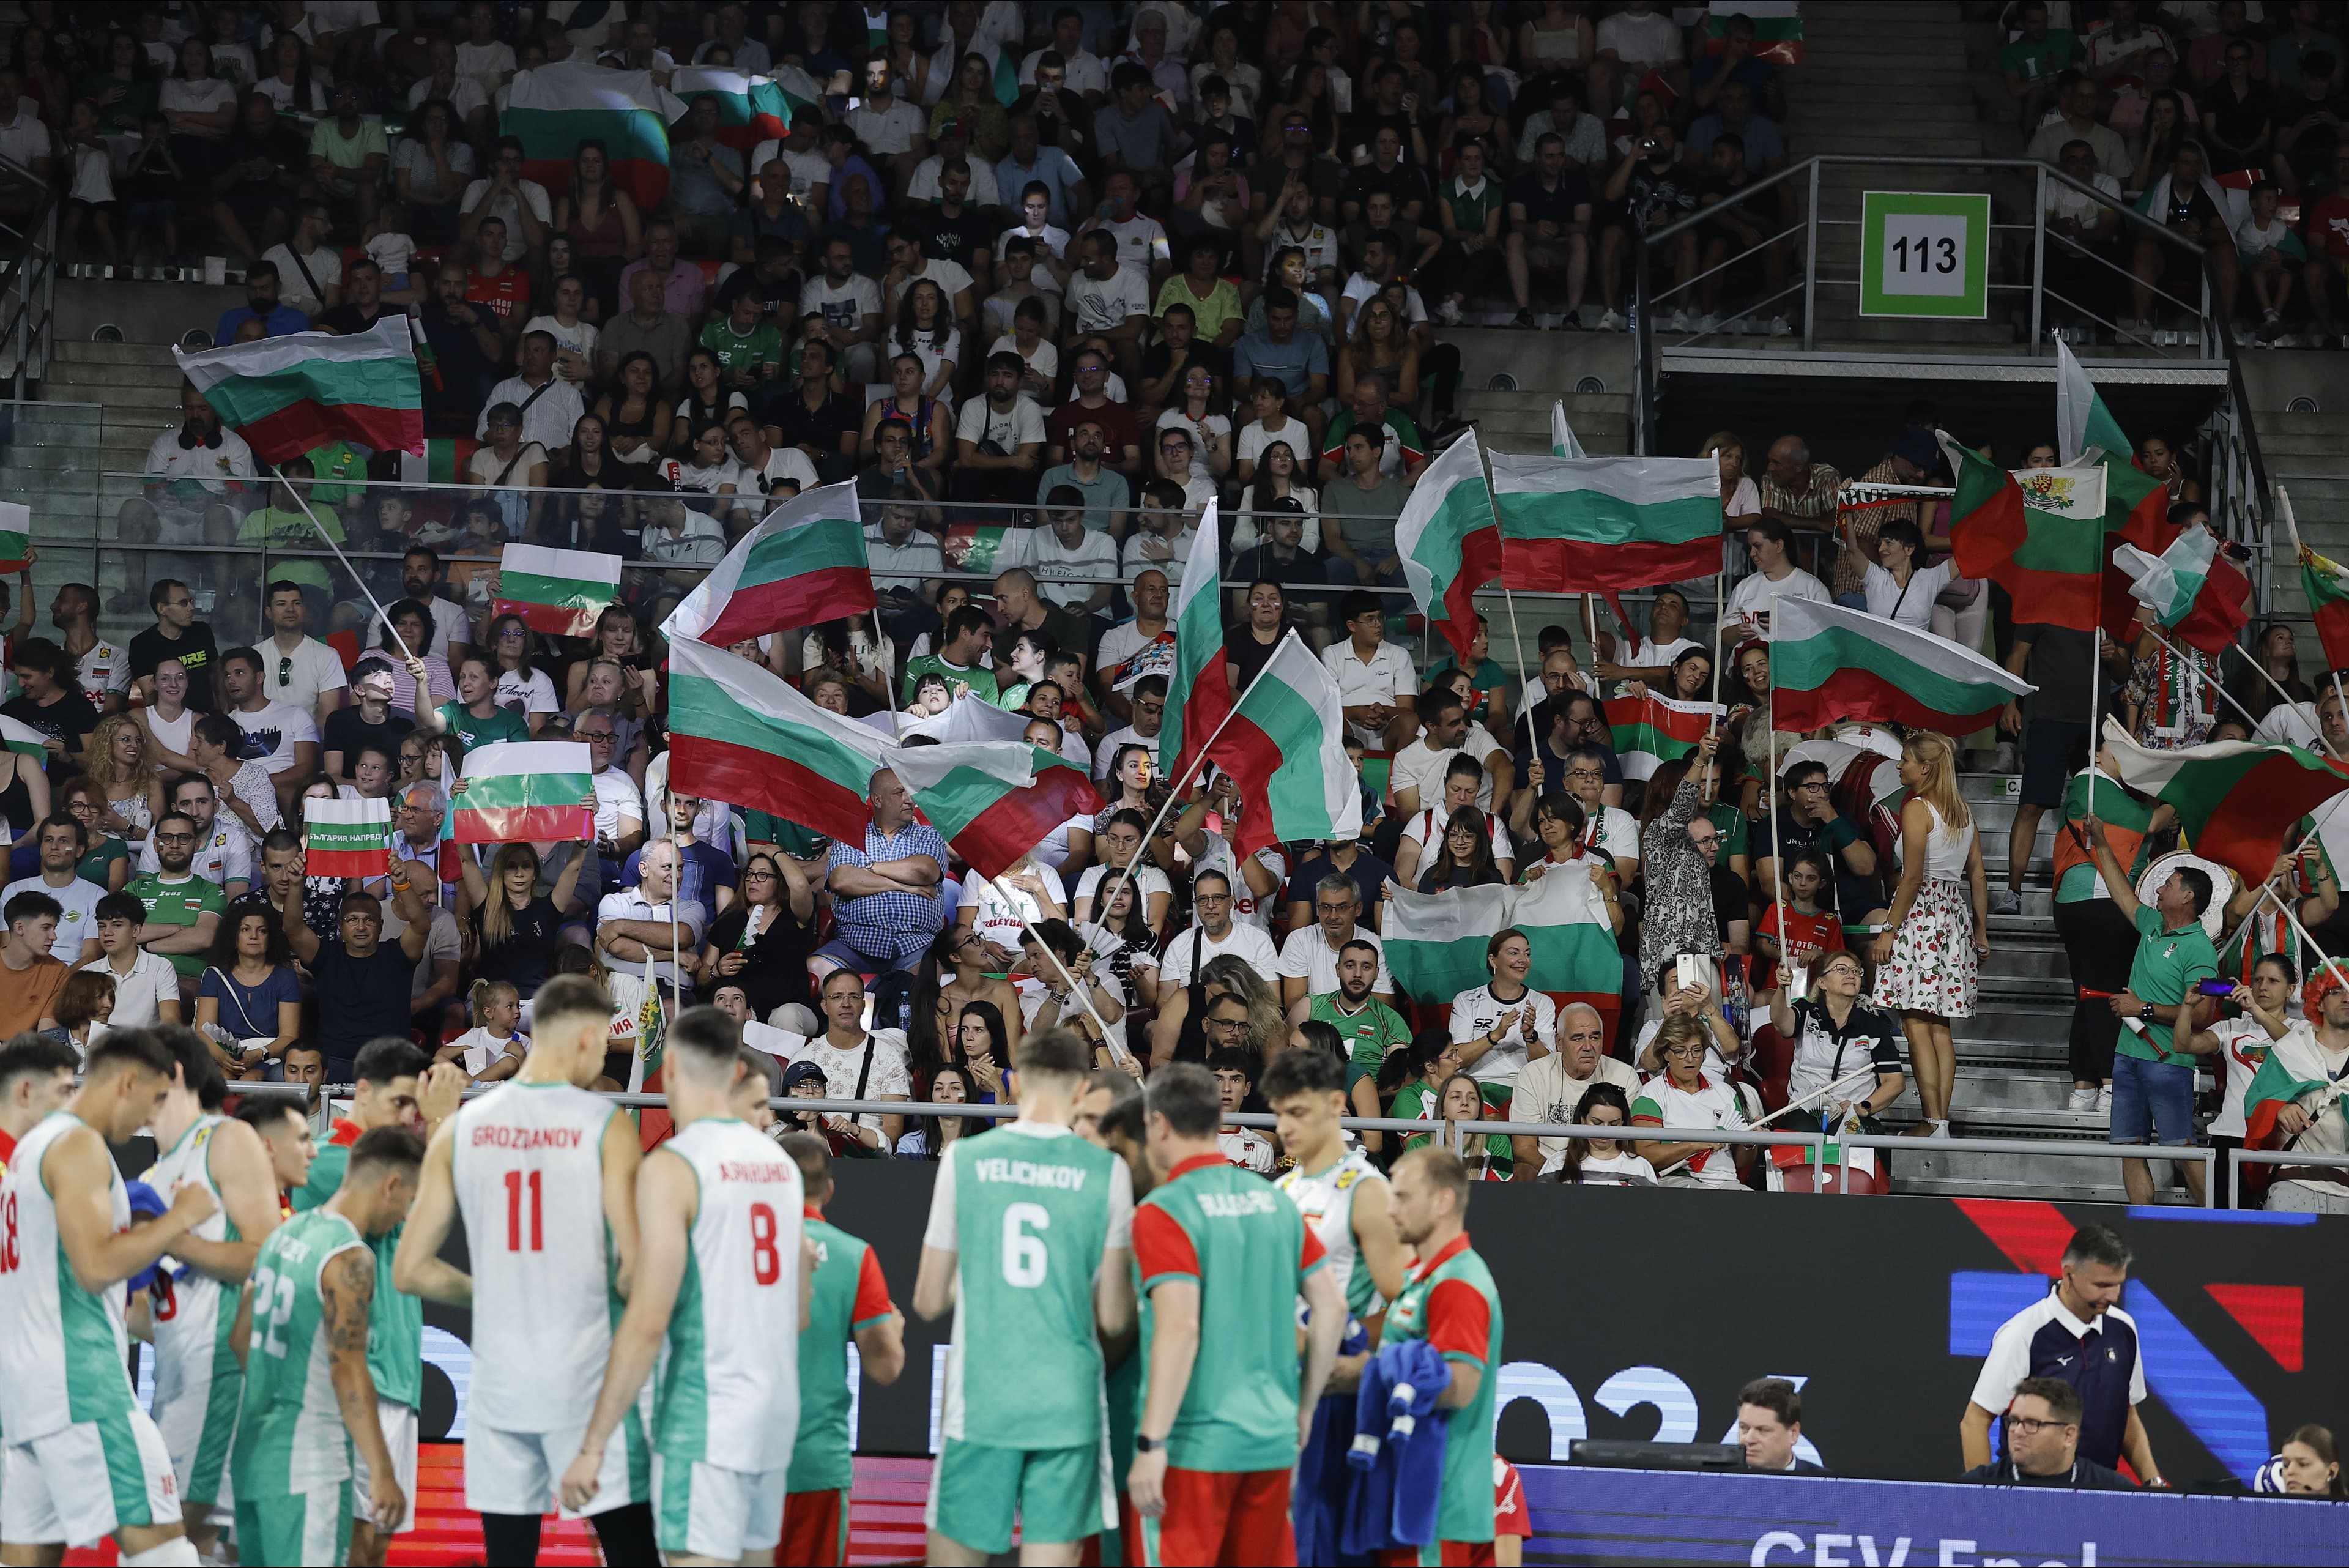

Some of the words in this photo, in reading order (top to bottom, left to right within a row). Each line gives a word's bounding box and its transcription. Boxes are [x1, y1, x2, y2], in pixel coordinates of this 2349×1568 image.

[1891, 236, 1957, 274] 113
[308, 833, 349, 843] БЪЛГАРИЯ,
[1473, 1017, 1493, 1029] SR
[974, 1157, 1088, 1192] VELICHKOV
[504, 1170, 543, 1252] 11
[751, 1203, 781, 1285] 8
[1001, 1202, 1052, 1289] 6
